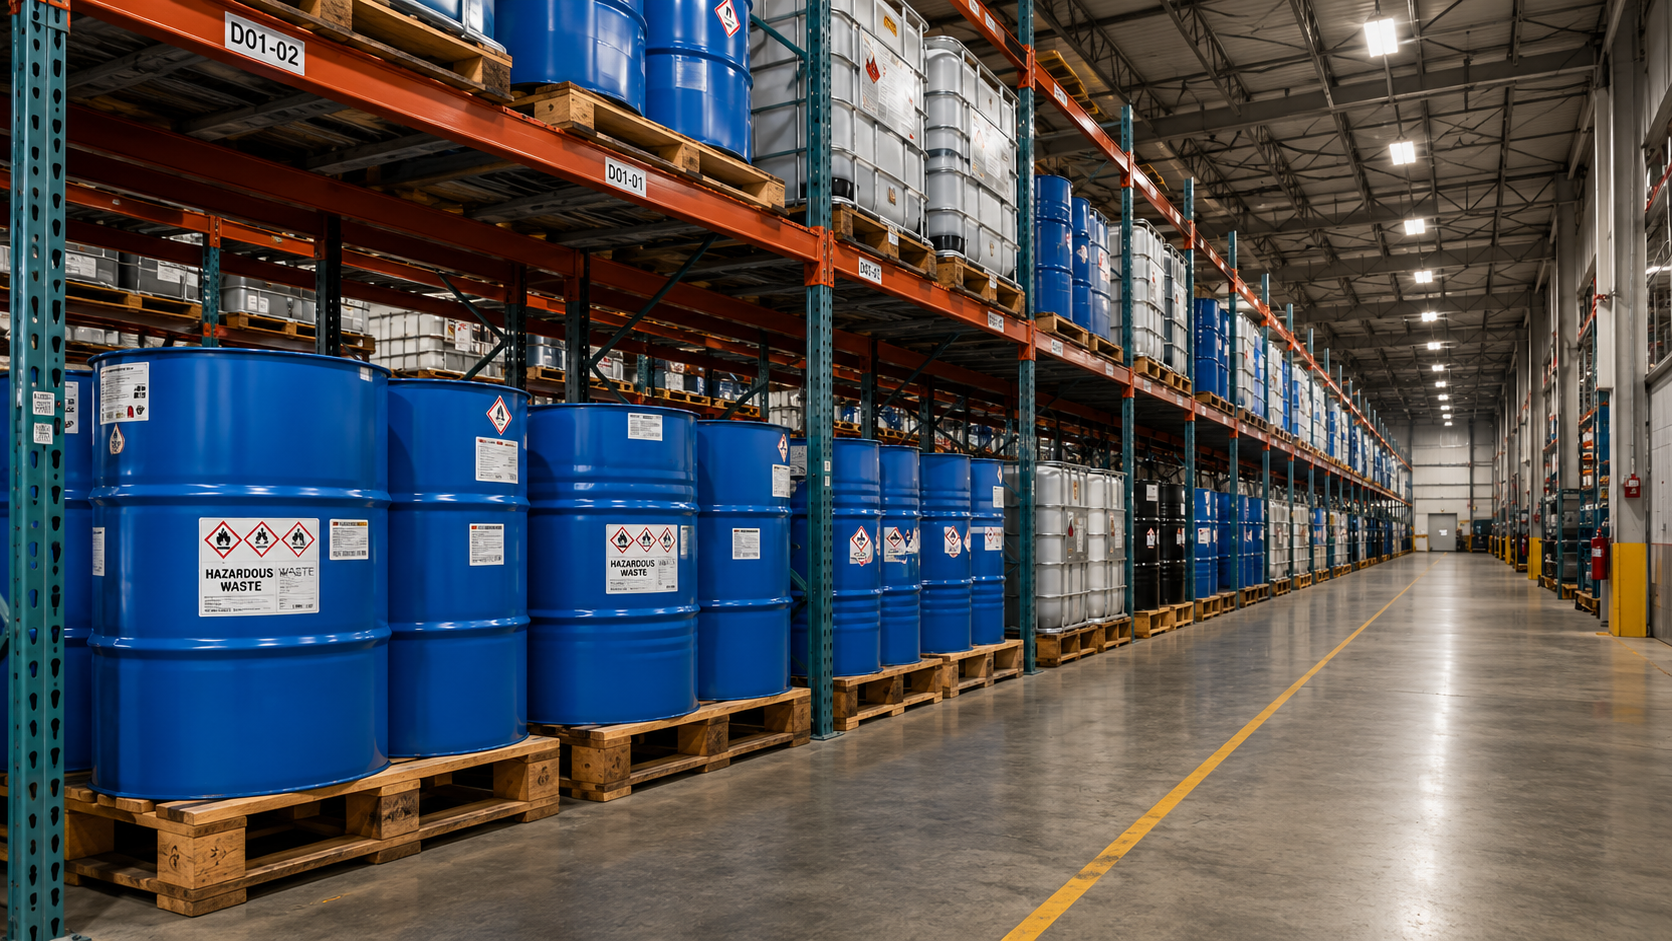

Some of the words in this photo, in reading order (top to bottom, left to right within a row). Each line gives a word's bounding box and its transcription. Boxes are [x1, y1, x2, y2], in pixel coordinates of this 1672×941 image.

[231, 21, 299, 66] D01-02
[609, 163, 642, 191] D01-01
[205, 568, 274, 579] HAZARDOUS
[620, 568, 648, 577] WASTE
[220, 581, 262, 592] WASTE
